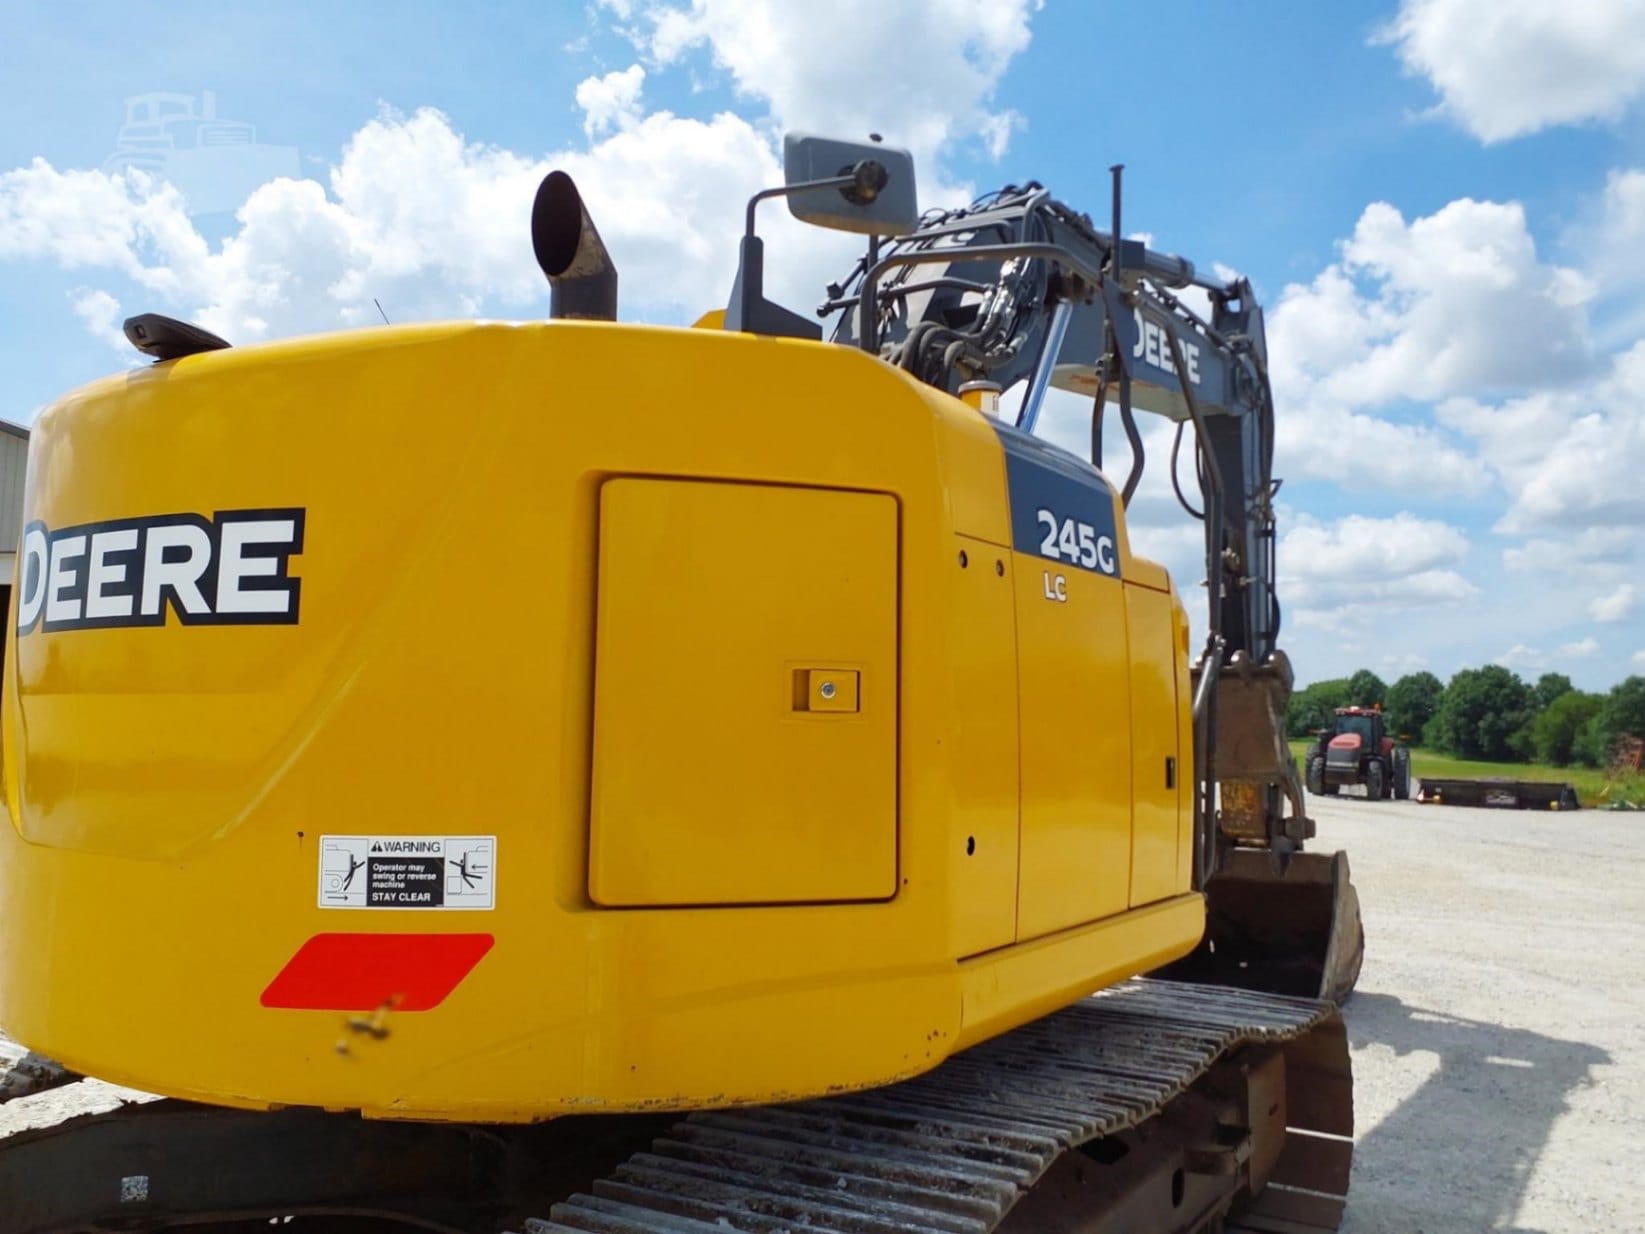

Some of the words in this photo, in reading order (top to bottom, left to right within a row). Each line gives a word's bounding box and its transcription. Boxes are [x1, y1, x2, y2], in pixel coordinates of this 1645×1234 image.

[1037, 509, 1115, 574] 245C
[18, 519, 295, 628] DEERE
[1044, 572, 1067, 602] LC
[384, 841, 441, 852] WARNING
[372, 863, 407, 873] Operator
[408, 865, 426, 873] may
[372, 872, 396, 881] swing
[372, 881, 405, 889] machine
[372, 892, 396, 901] STAY
[398, 892, 431, 901] CLEAR
